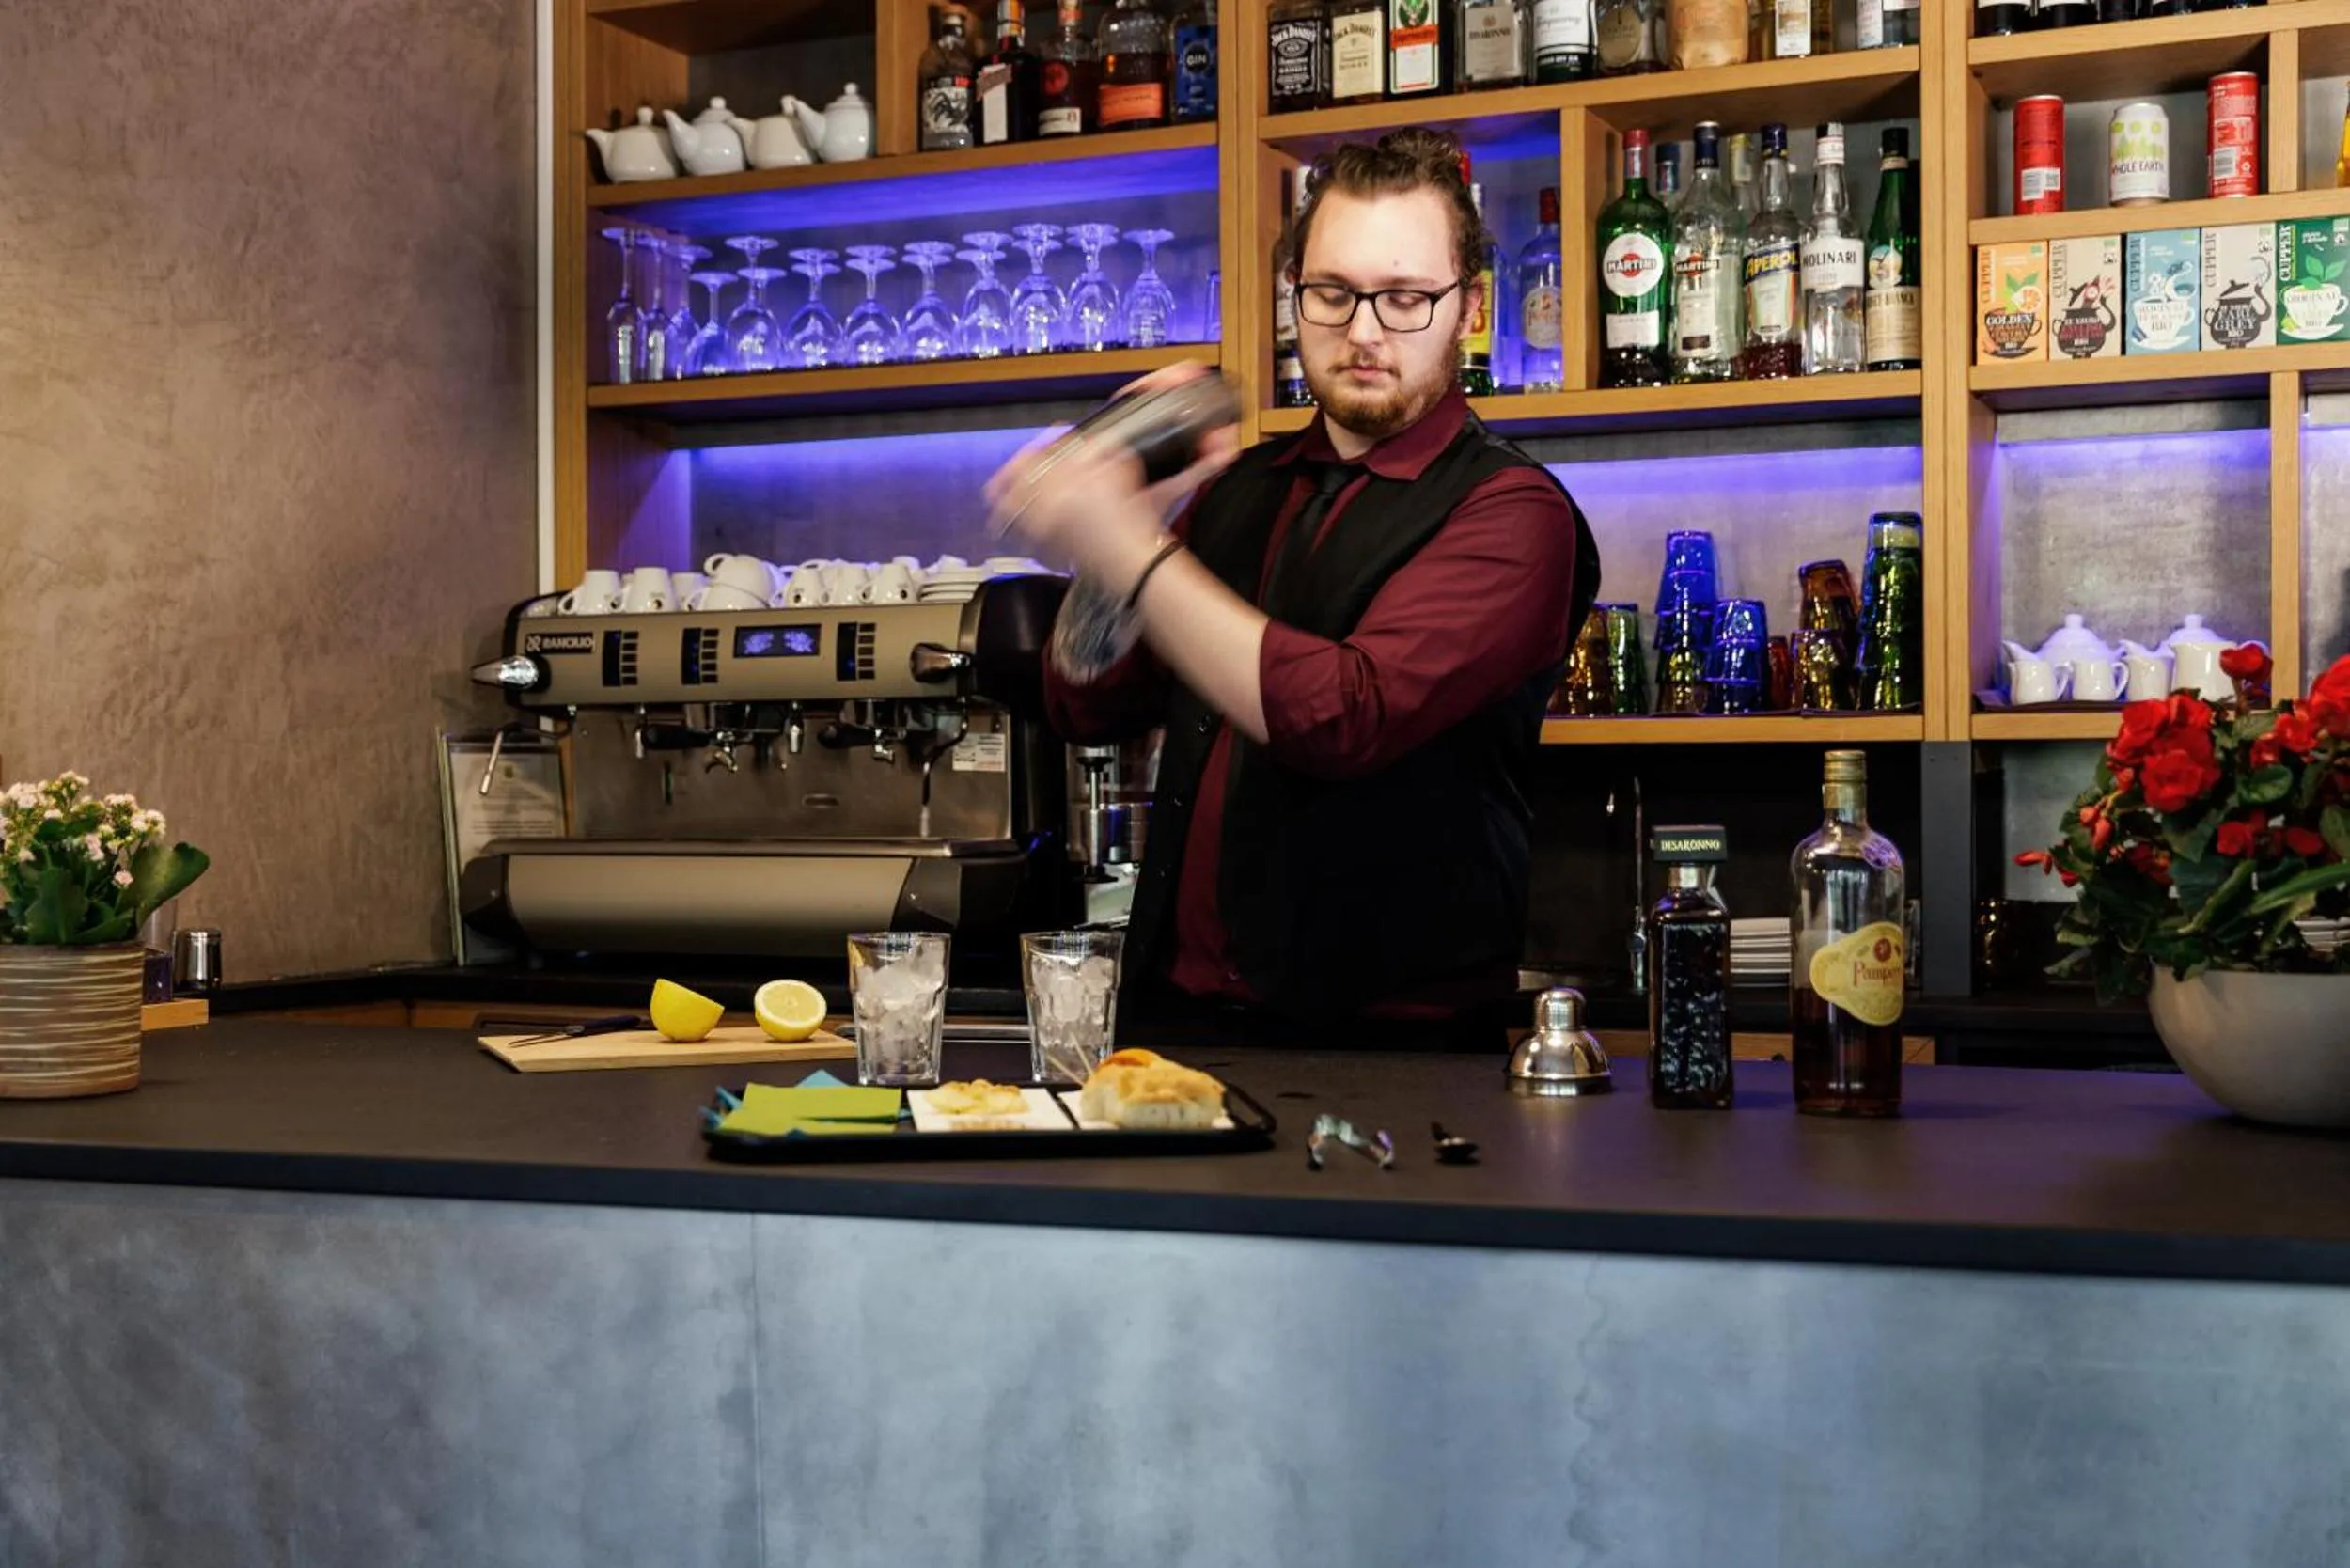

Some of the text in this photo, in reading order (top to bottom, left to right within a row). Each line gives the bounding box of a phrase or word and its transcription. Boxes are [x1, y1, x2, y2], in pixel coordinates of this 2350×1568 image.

[1747, 250, 1796, 276] APEROL
[2280, 225, 2292, 281] CUPPER
[1607, 259, 1655, 274] MARTINI
[1985, 313, 2032, 326] GOLDEN
[1660, 839, 1721, 852] DISARONNO
[1854, 961, 1902, 988] Pamper
